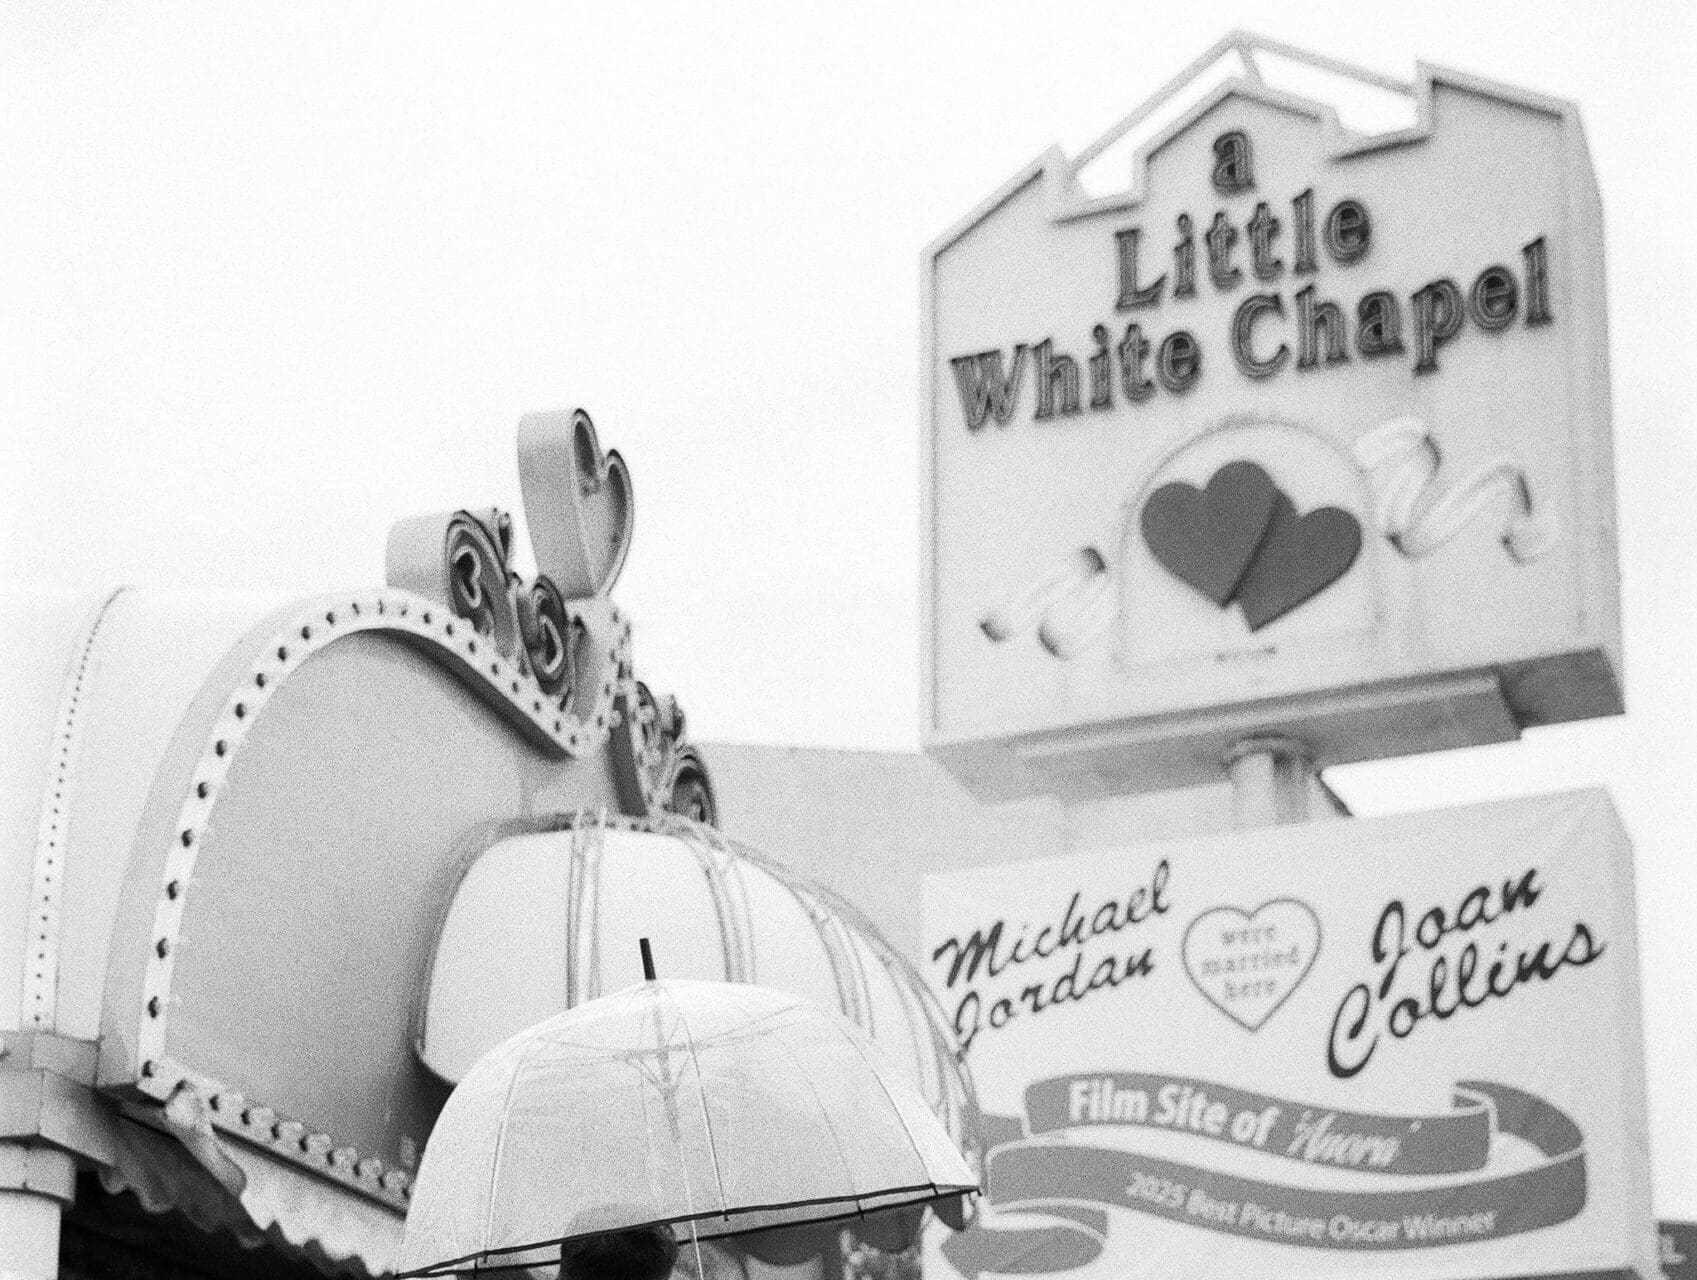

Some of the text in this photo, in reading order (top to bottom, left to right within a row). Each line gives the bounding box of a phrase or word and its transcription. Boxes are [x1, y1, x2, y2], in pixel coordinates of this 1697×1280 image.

[1212, 130, 1255, 197] a
[1114, 188, 1371, 312] Little
[950, 236, 1552, 430] White Chapel
[934, 858, 1171, 988] Michael
[1202, 945, 1301, 975] married
[1220, 925, 1277, 948] were
[1372, 867, 1544, 1000] Joan
[953, 946, 1156, 1062] Jordan
[1223, 980, 1276, 1001] here
[1328, 922, 1606, 1079] Collins
[1068, 1078, 1148, 1124] Film
[1153, 1084, 1230, 1136] Site
[1230, 1106, 1280, 1148] of
[1126, 1172, 1498, 1244] 2025 Best Picture Oscar Winner
